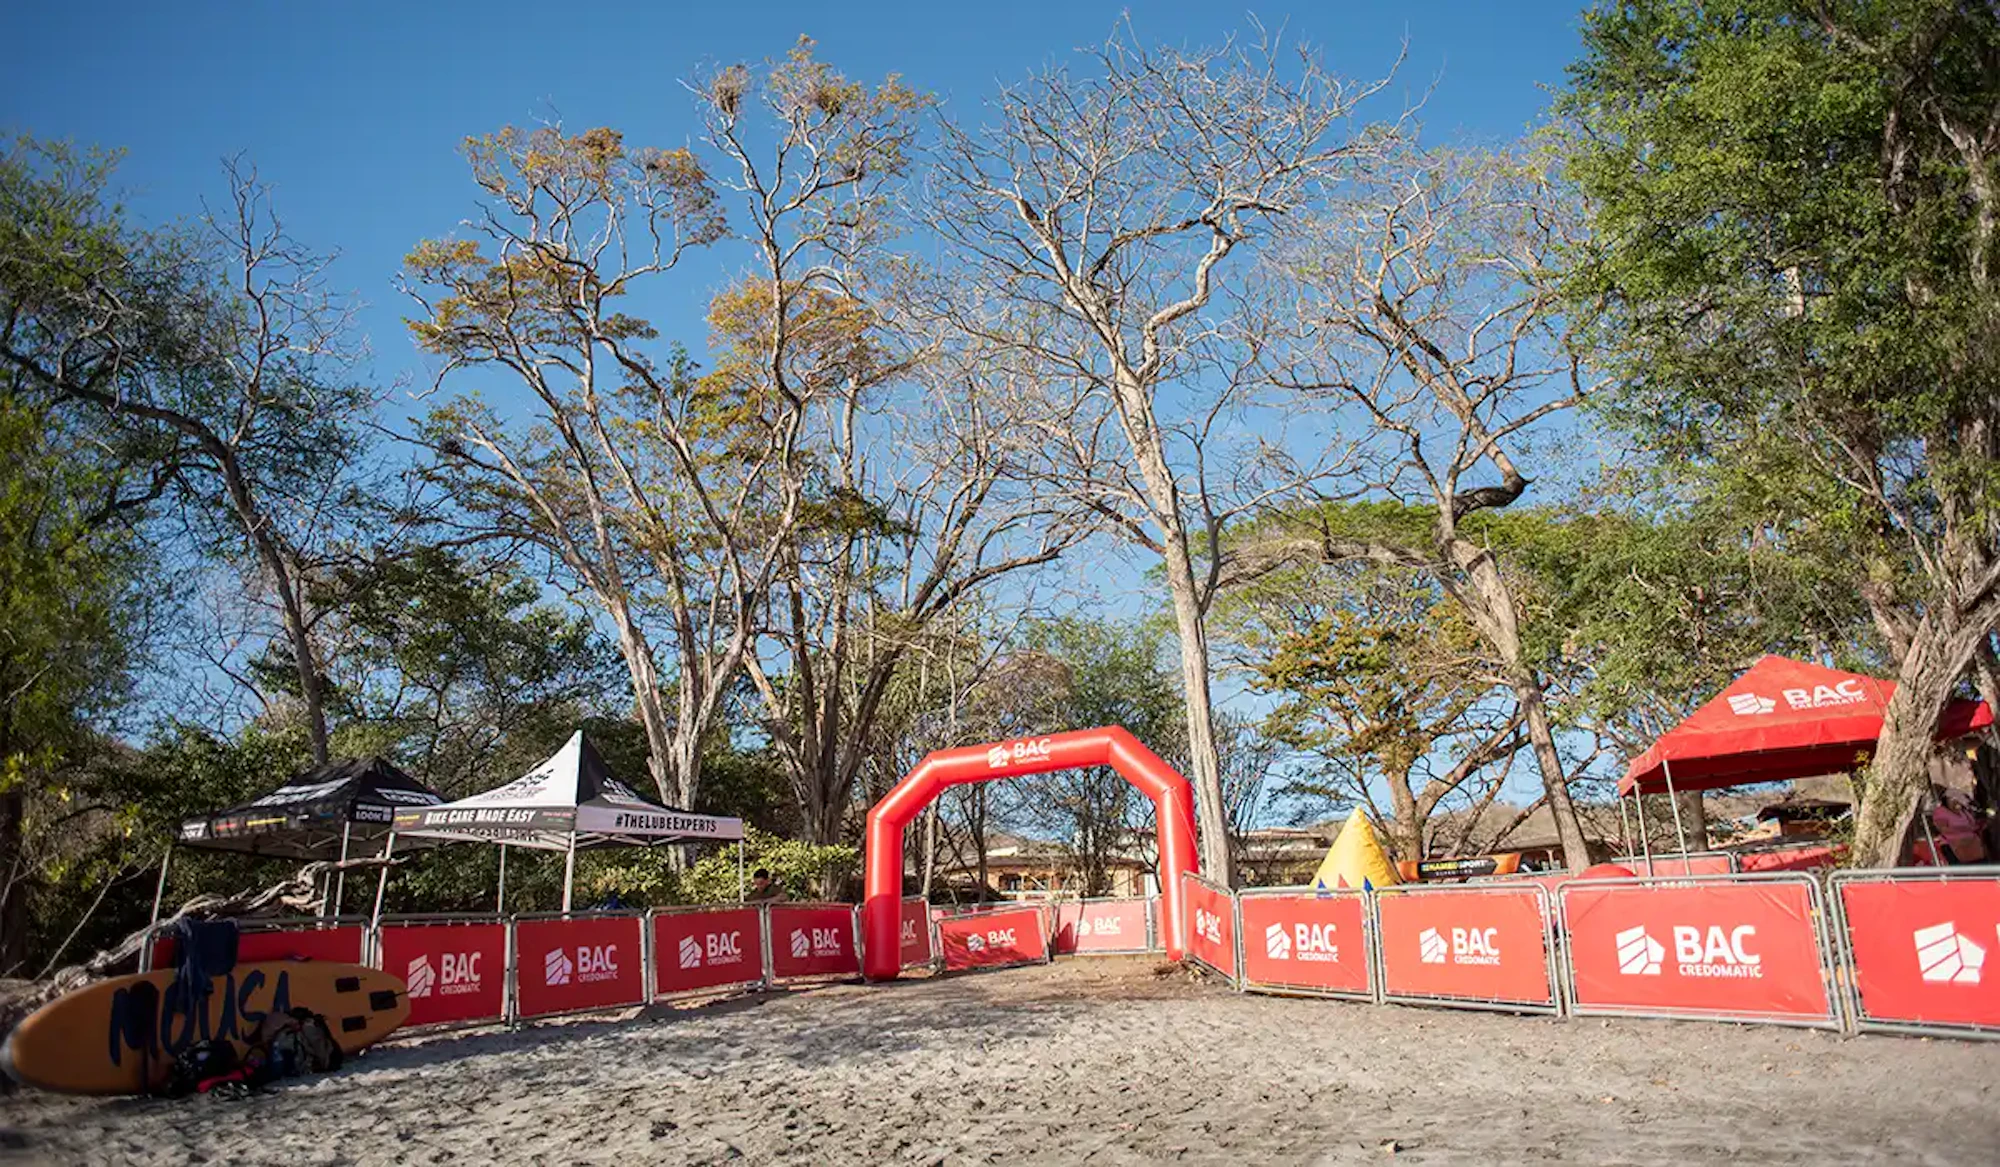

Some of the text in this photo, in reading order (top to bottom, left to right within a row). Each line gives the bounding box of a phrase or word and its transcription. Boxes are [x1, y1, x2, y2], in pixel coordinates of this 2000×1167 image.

[1782, 679, 1863, 709] BAC
[1013, 738, 1051, 758] BAC
[424, 811, 450, 825] BIKE
[448, 810, 475, 823] CARE
[475, 809, 505, 822] MADE
[507, 809, 537, 823] EASY
[615, 813, 717, 832] #THELUBEEXPERTS
[900, 919, 917, 940] AC
[1094, 916, 1121, 931] BAC
[706, 931, 742, 958] BAC
[812, 927, 841, 949] BAC
[988, 927, 1017, 945] BAC
[1295, 922, 1338, 953] BAC
[1452, 927, 1500, 956] BAC
[1673, 925, 1761, 965] BAC
[441, 951, 481, 985] BAC
[577, 944, 618, 974] BAC
[1679, 963, 1763, 978] CREDOMATIC
